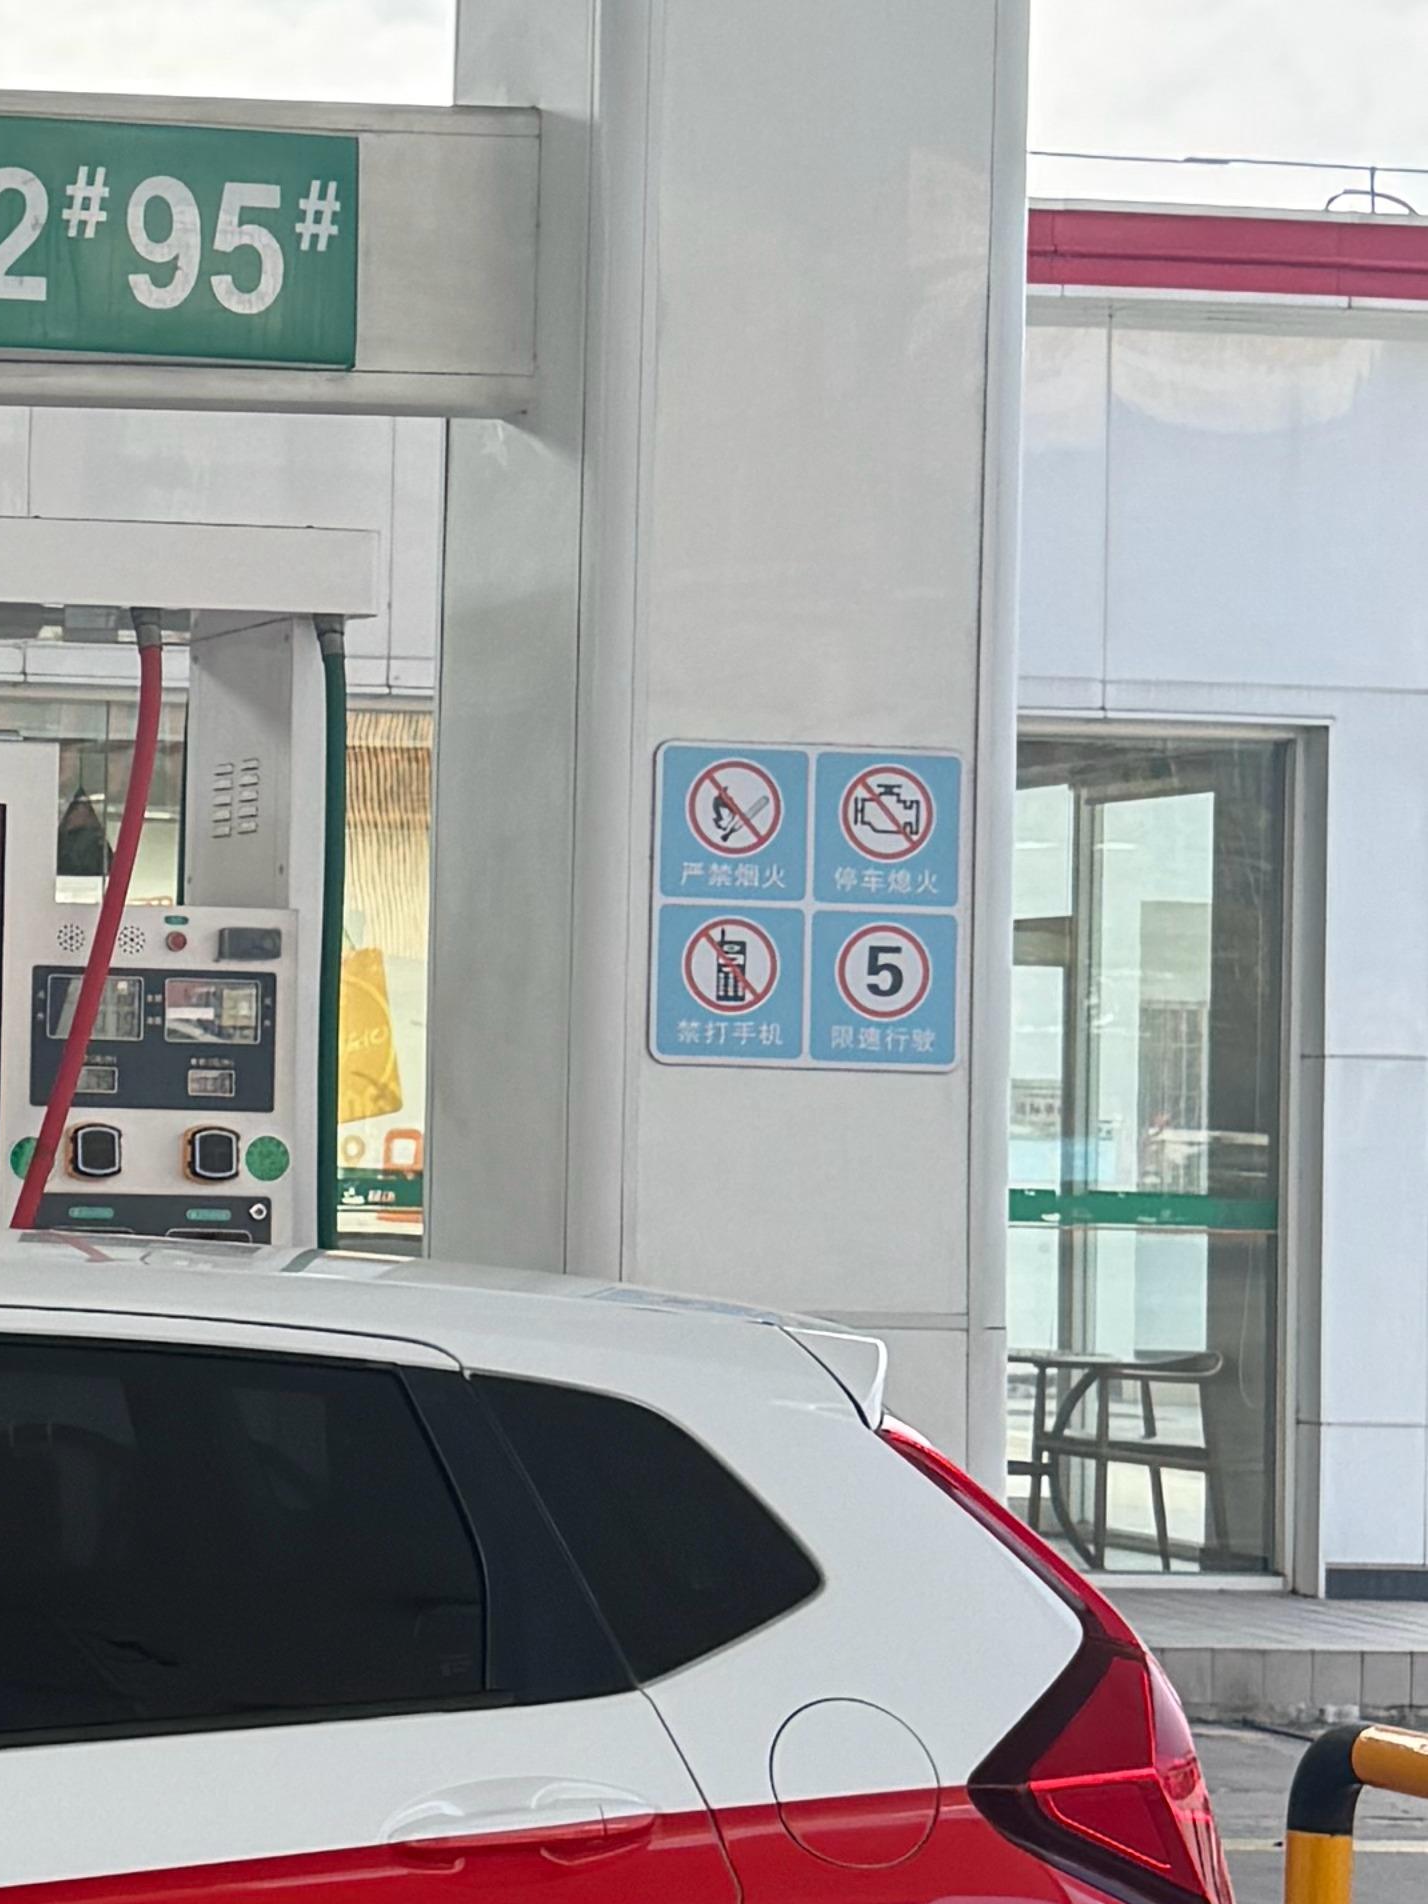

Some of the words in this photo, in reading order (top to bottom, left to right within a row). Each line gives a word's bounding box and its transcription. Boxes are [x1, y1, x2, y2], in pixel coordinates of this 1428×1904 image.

[680, 861, 787, 889] 严禁烟火
[834, 866, 939, 894] 停车熄火
[866, 945, 904, 997] 5
[676, 1020, 784, 1046] 禁打手机
[830, 1024, 937, 1053] 限速行驶
